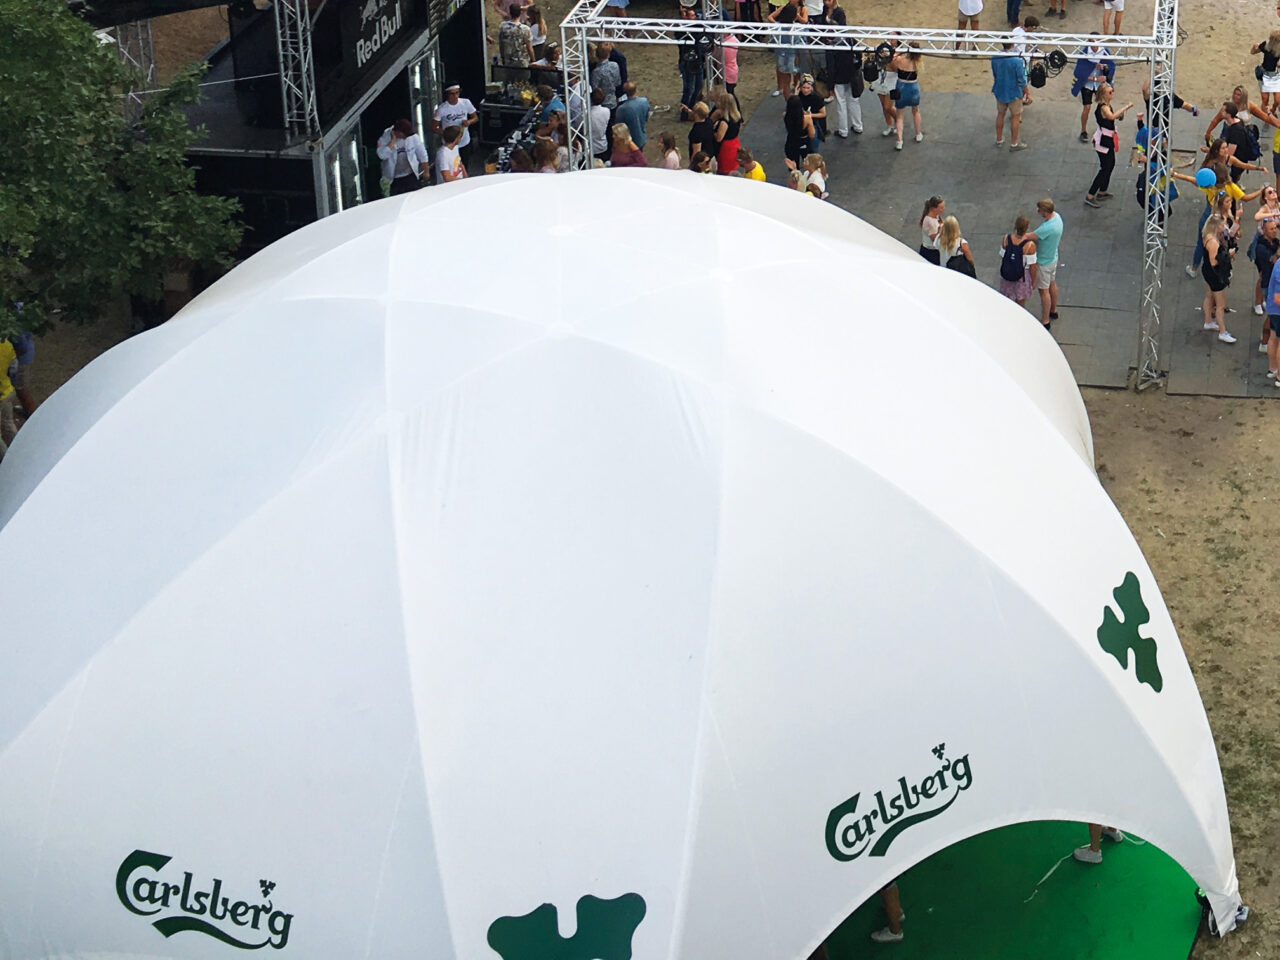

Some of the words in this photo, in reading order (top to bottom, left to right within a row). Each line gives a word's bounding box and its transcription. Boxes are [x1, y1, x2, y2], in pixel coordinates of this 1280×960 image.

[356, 20, 381, 68] Red
[381, 0, 402, 44] Bull
[824, 752, 973, 862] Carlsberg
[115, 849, 295, 950] Carlsberg
